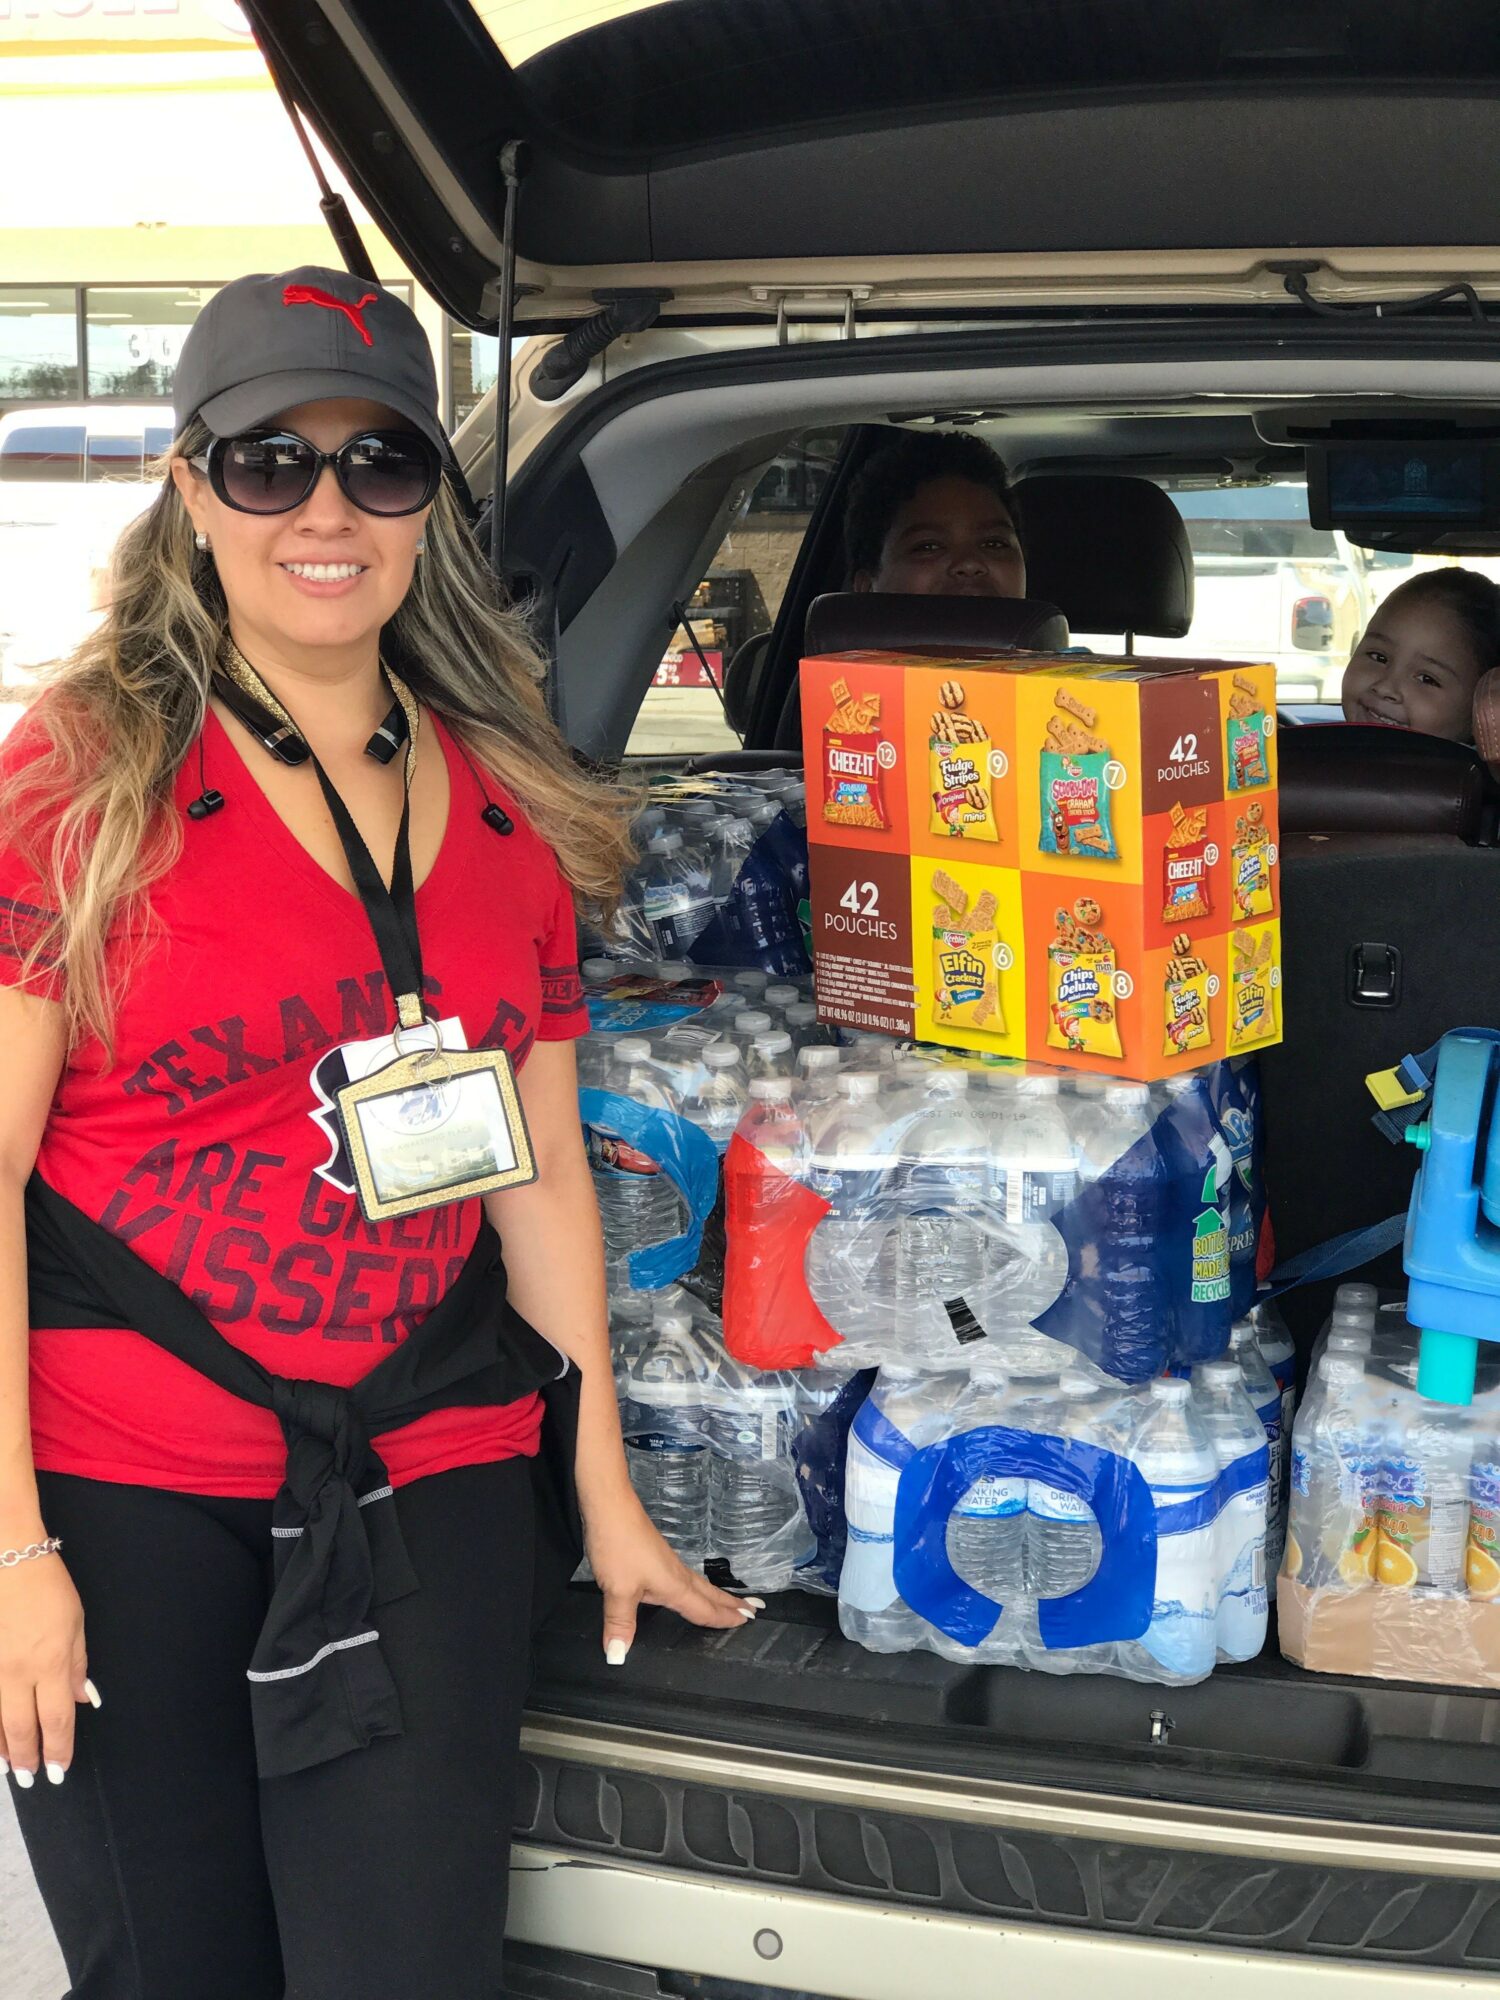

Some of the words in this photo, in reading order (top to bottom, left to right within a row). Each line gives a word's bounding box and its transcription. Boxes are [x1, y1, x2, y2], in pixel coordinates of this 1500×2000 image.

[1264, 718, 1272, 734] 7
[879, 747, 894, 763] 12
[1169, 733, 1198, 763] 42
[828, 748, 875, 777] CHEEZ-IT
[940, 758, 974, 775] Fudge
[992, 755, 1003, 774] 9
[1157, 760, 1210, 783] POUCHES
[943, 771, 979, 788] Stripes
[1108, 765, 1121, 785] 7
[942, 792, 965, 805] Original
[1067, 797, 1095, 811] GRAHAM
[963, 811, 986, 823] minis
[1206, 847, 1216, 860] 12
[1168, 859, 1203, 880] CHEEZ-IT
[839, 879, 880, 917] 42
[824, 912, 898, 941] POUCHES
[941, 951, 984, 976] Elfin
[997, 947, 1009, 967] 6
[945, 972, 983, 986] Crackers
[1062, 967, 1094, 984] Chips
[1116, 975, 1128, 995] 8
[1208, 978, 1217, 992] 9
[1059, 981, 1099, 1000] Deluxe
[1238, 983, 1264, 1002] Elfin
[818, 1005, 826, 1017] NET
[123, 1138, 285, 1224] ARE
[1195, 1259, 1221, 1278] MADE
[973, 1487, 1009, 1498] NKING
